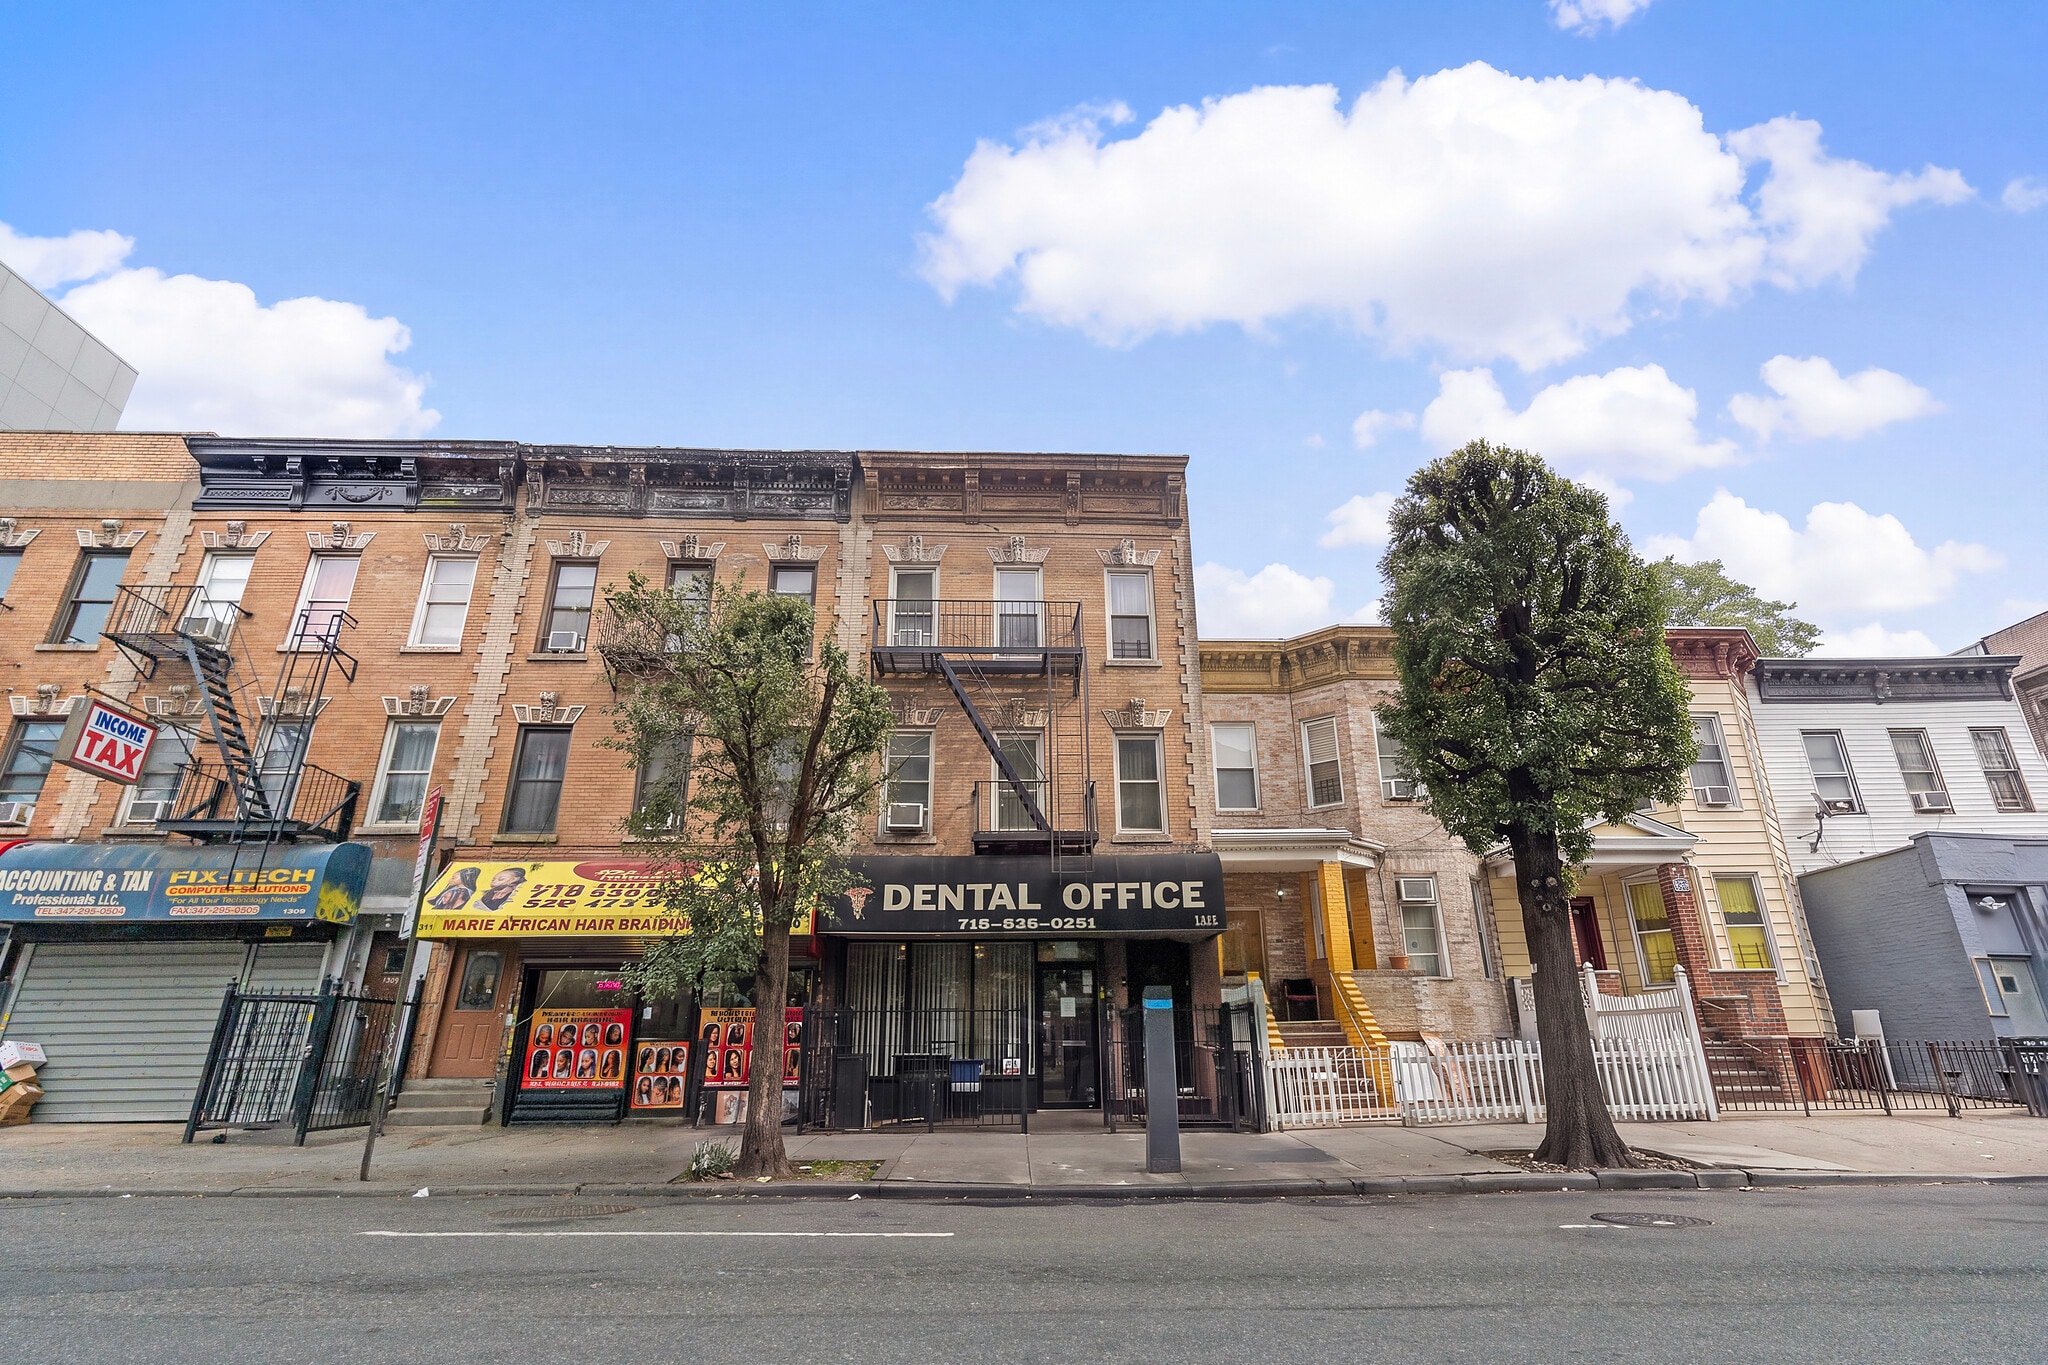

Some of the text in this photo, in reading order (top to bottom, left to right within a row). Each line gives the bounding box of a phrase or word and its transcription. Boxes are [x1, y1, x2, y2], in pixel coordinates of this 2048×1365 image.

[95, 710, 147, 744] INCOME
[83, 729, 143, 775] TAX
[0, 870, 154, 892] ACCOUNTING & TAX
[169, 869, 316, 884] FIX-TECH
[169, 885, 308, 895] COMPUTER SOLUTIONS
[882, 880, 1205, 911] DENTAL OFFICE
[12, 893, 120, 906] Professionals LLC.
[222, 896, 268, 905] Technology
[418, 923, 434, 931] 311
[442, 916, 691, 931] MARIE AFRICAN HAIR BRAIDIN
